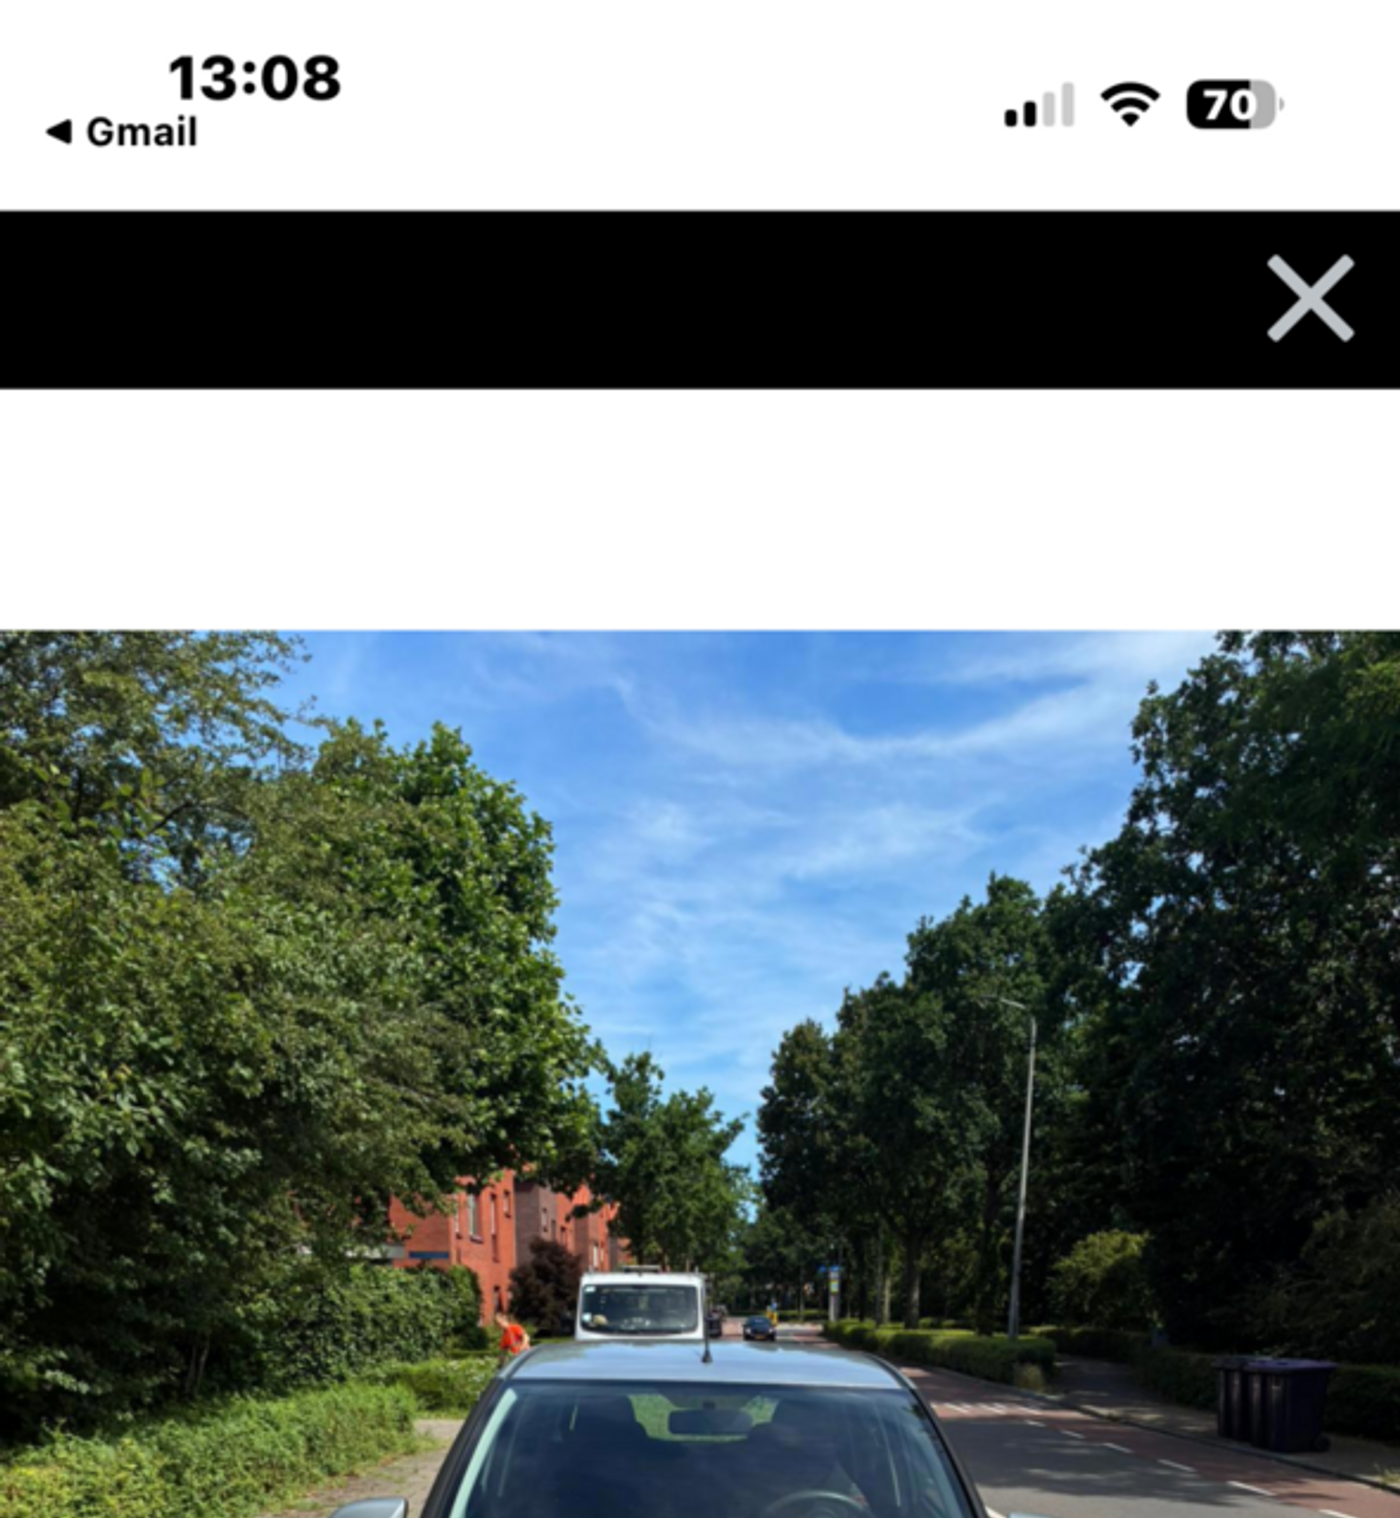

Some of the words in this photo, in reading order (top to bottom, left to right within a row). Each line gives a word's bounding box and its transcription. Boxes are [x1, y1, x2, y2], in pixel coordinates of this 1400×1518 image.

[169, 54, 341, 101] 13:08
[1203, 89, 1257, 120] 70
[87, 114, 196, 147] Gmail
